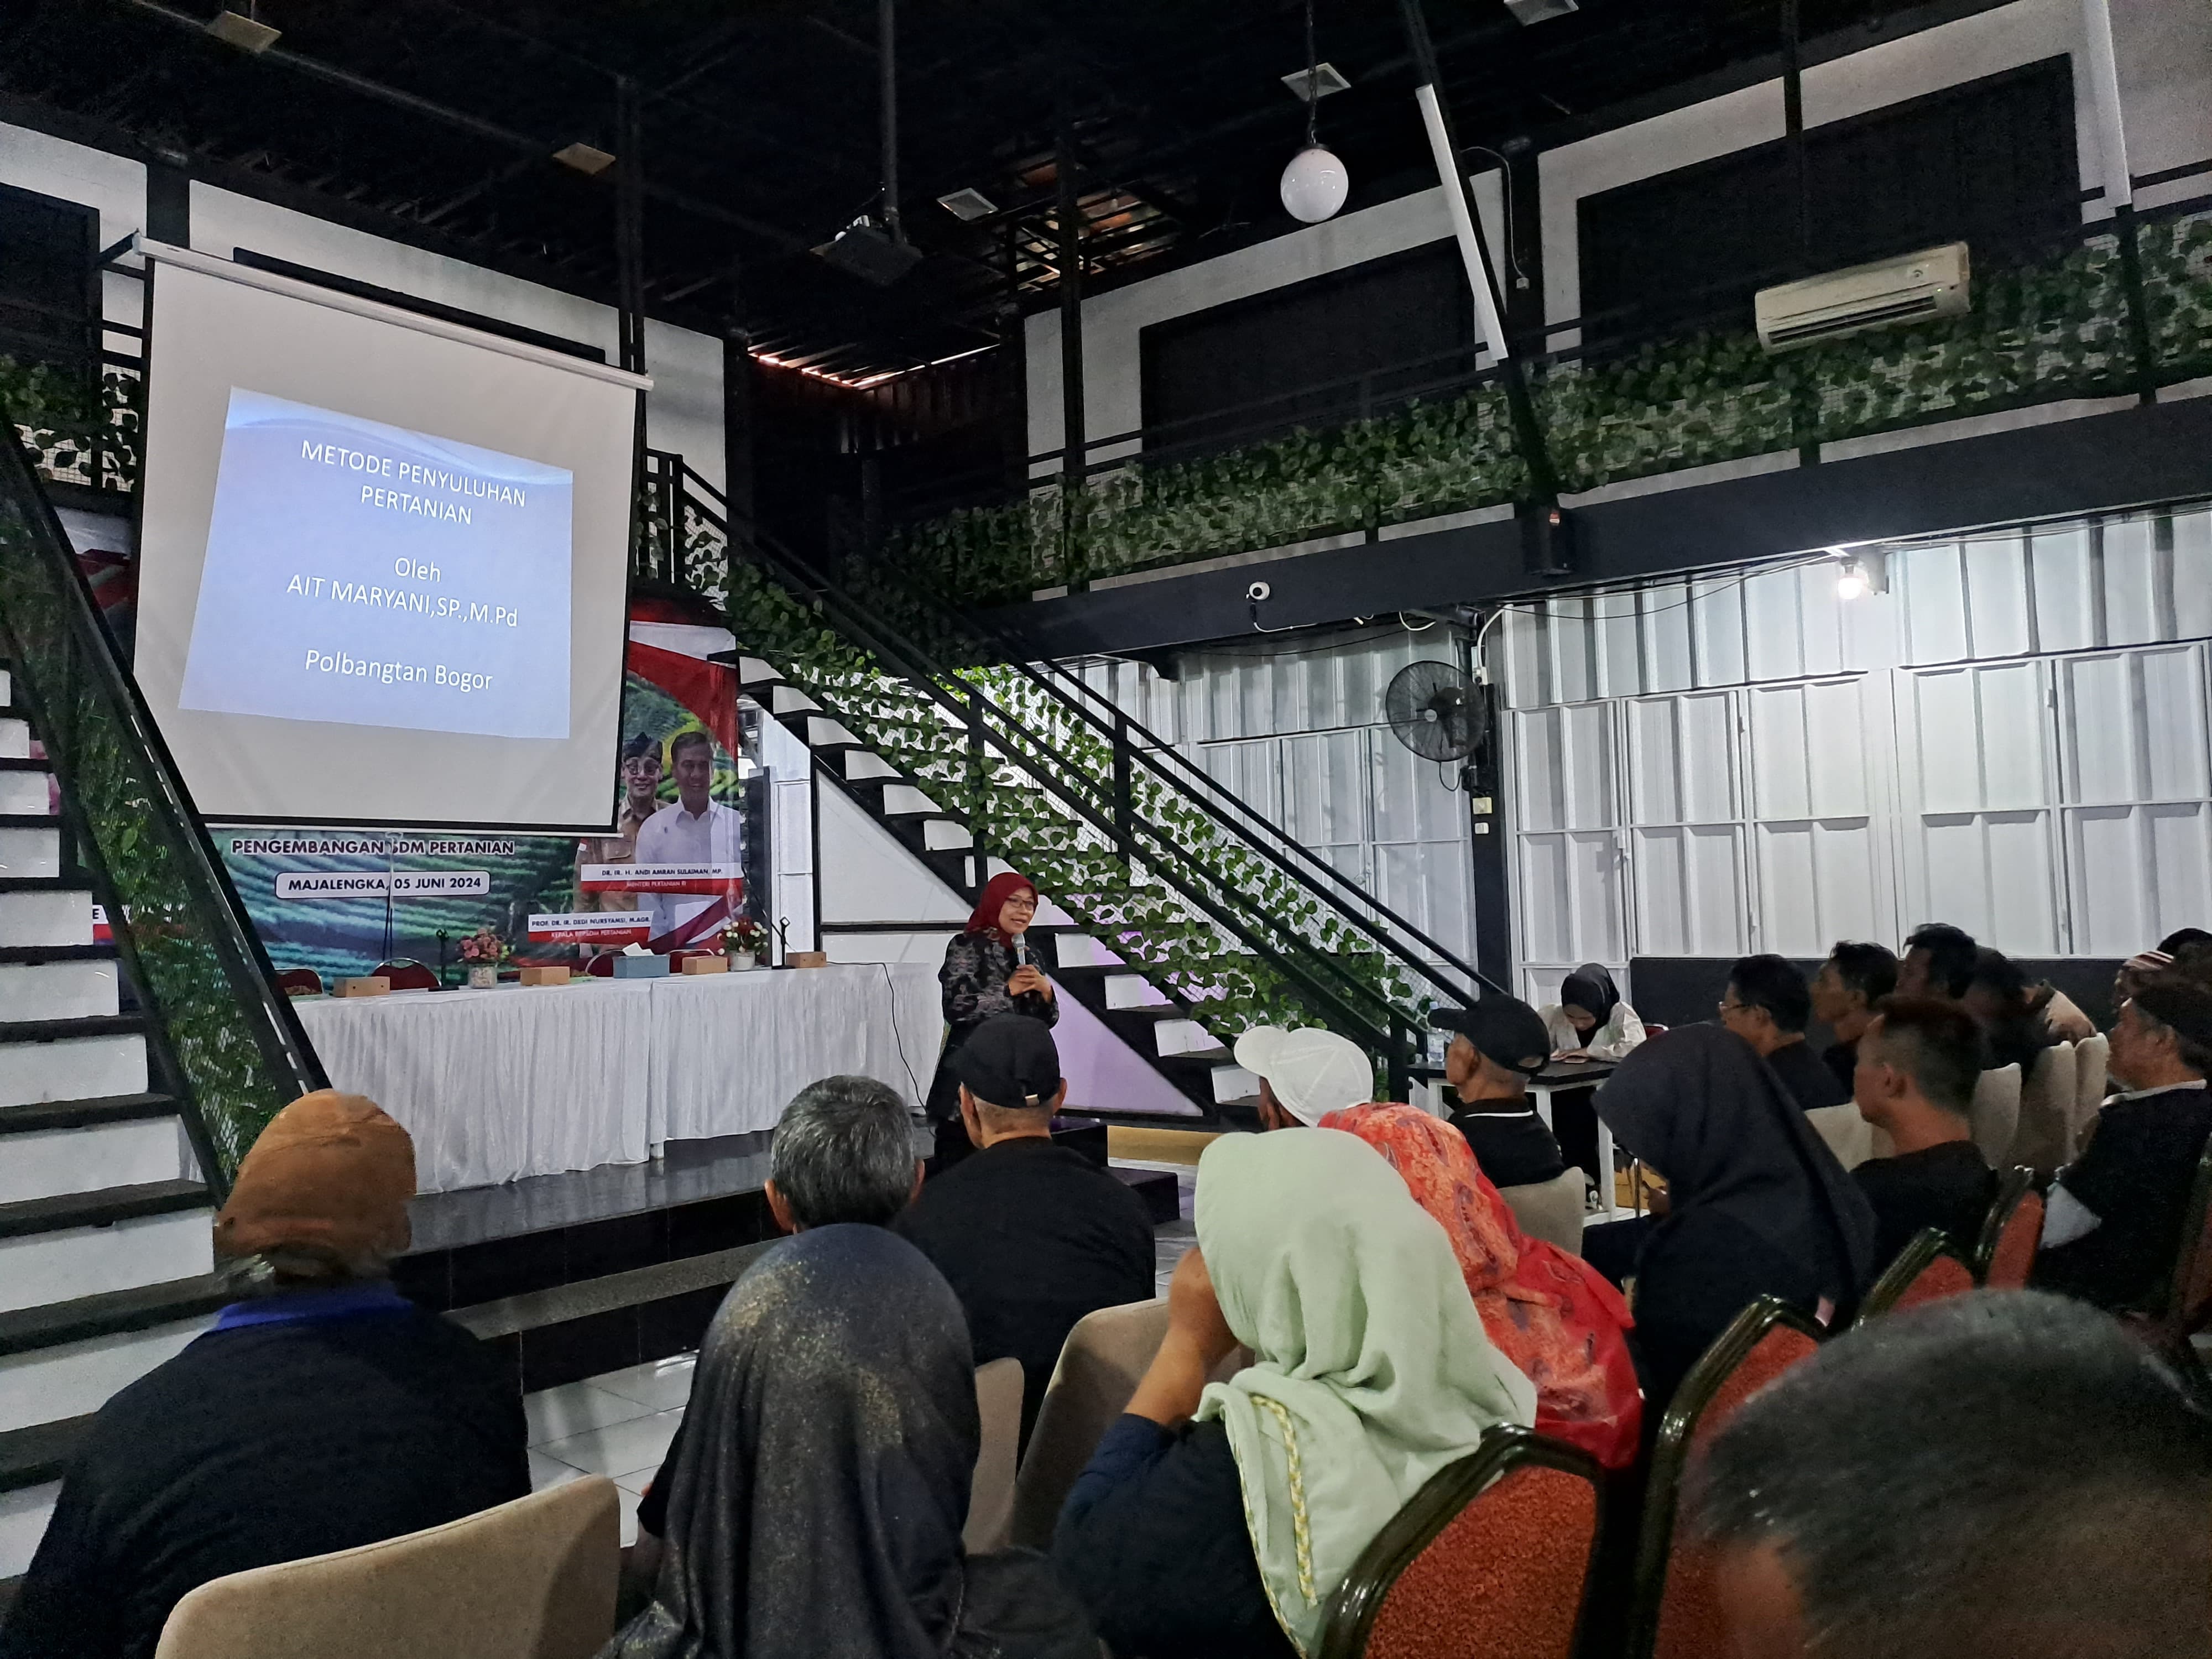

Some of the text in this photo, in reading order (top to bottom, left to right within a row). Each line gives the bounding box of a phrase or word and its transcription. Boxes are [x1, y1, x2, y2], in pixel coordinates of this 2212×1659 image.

[301, 440, 526, 507] METODE PENYULUHAN
[361, 485, 472, 525] PERTANIAN
[394, 557, 441, 582] Oleh
[286, 575, 325, 597] AIT
[305, 649, 493, 693] Polbangtan Bogor
[231, 840, 384, 854] PENGEMBANGAN
[429, 840, 514, 855] PERTANIAN
[288, 877, 481, 891] MAJALENGKA, 05 JUNI 2024
